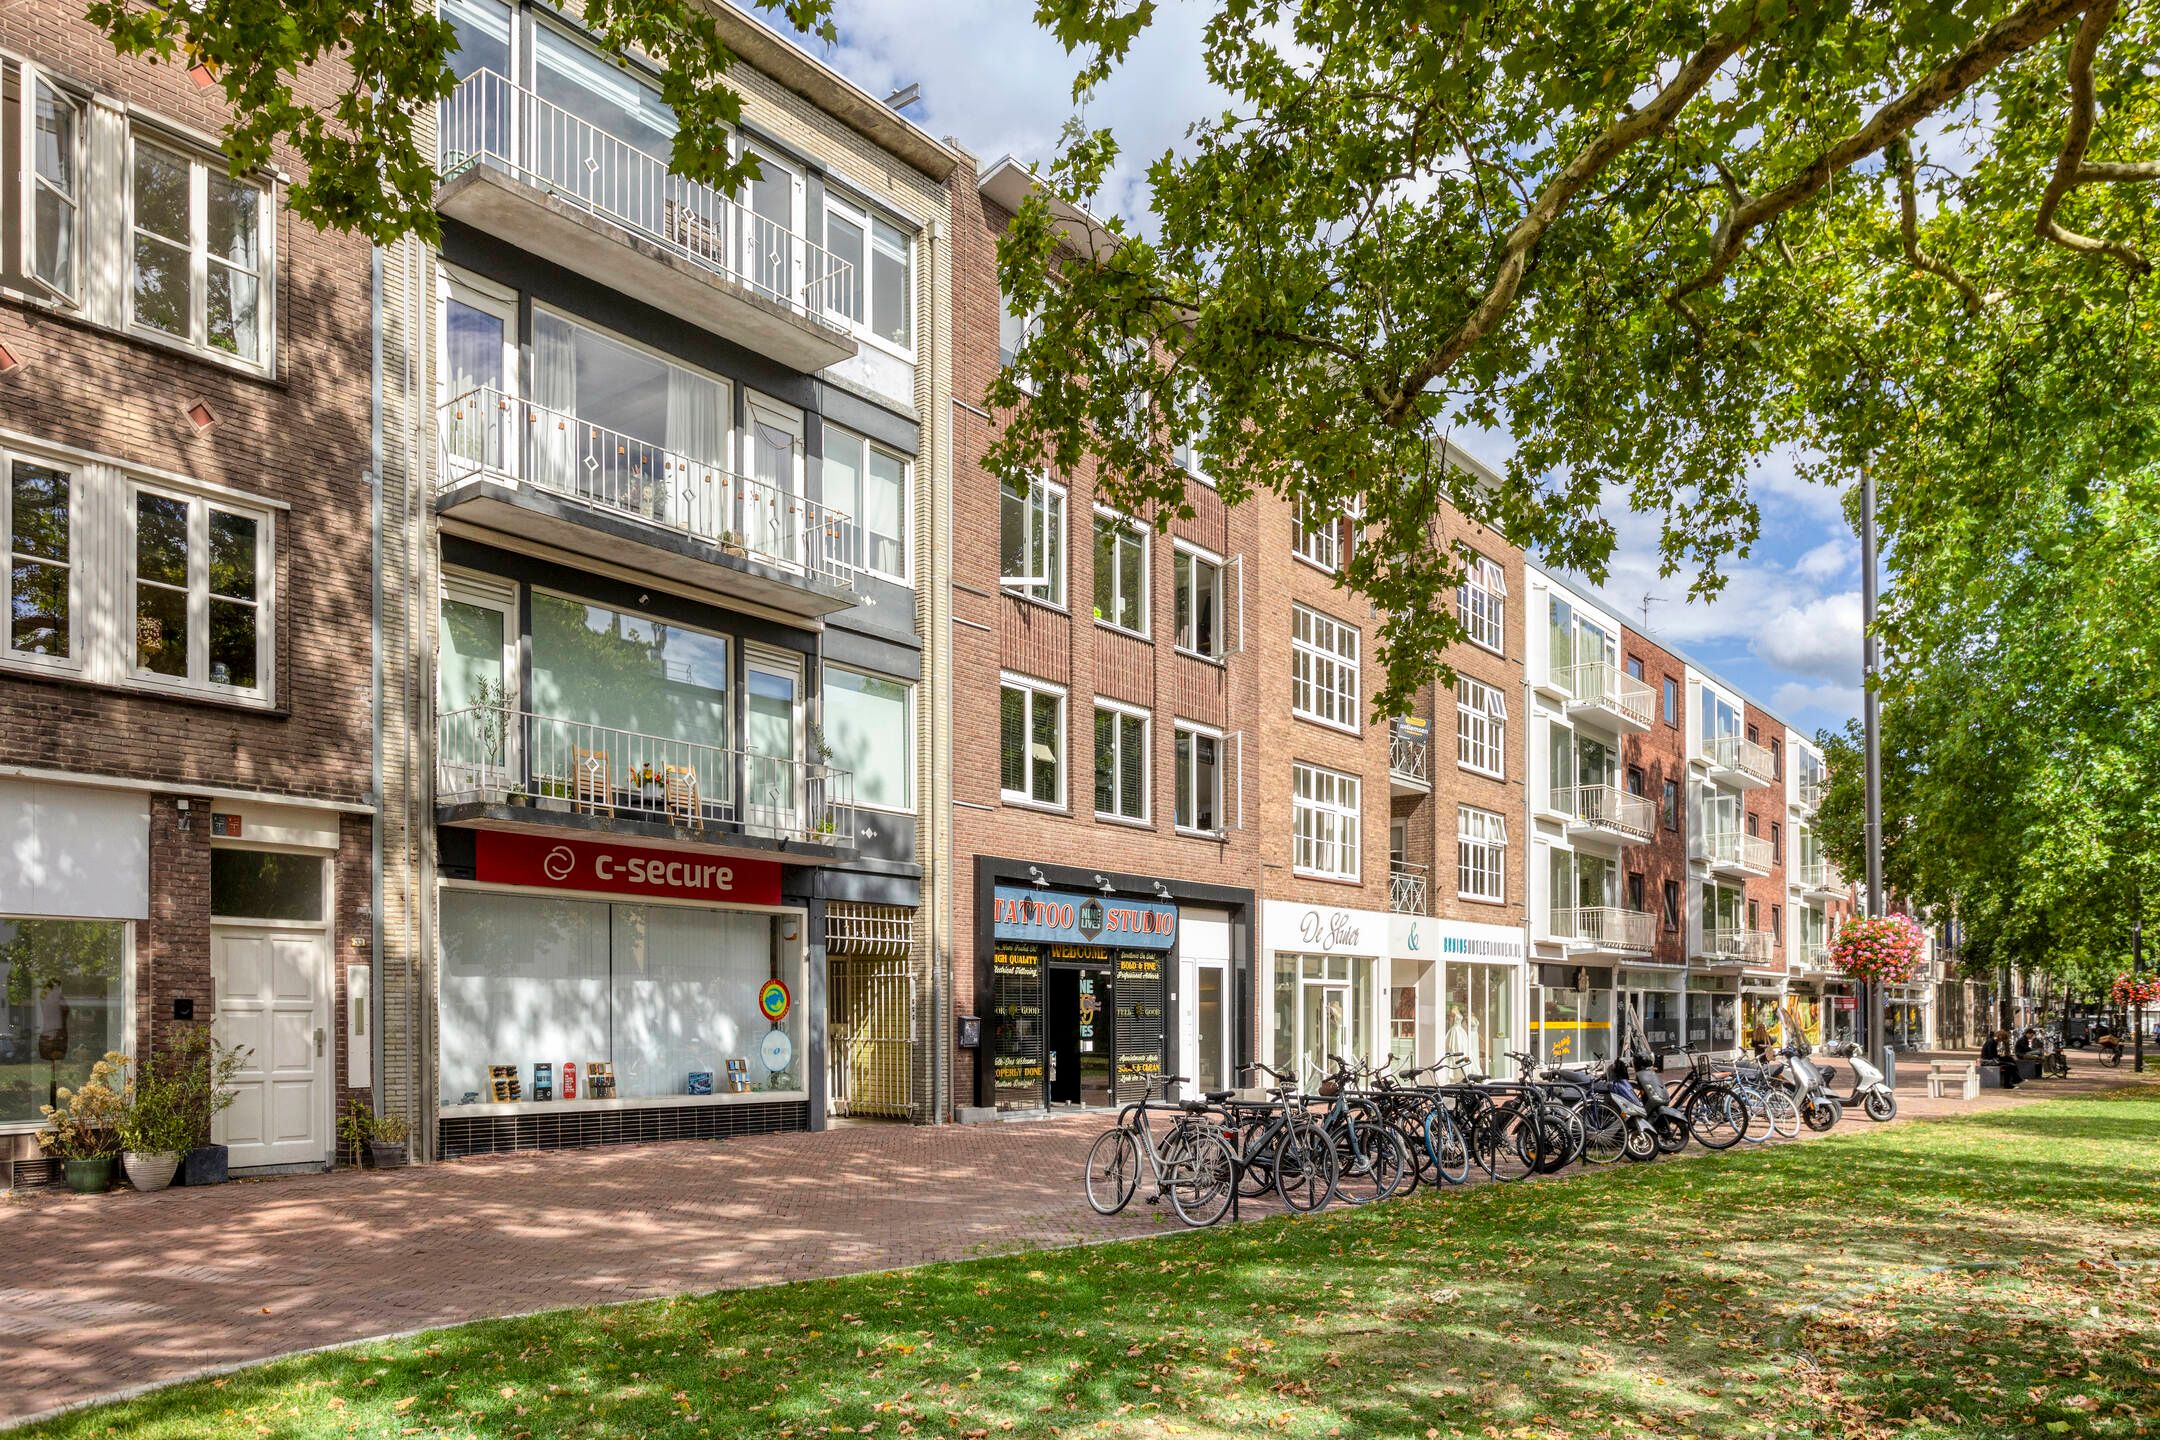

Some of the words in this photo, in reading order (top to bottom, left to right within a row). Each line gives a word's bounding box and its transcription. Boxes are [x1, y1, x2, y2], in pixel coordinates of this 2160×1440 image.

[595, 854, 734, 891] c-secure
[995, 897, 1074, 929] TATTOO
[1106, 907, 1174, 936] STUDIO
[1081, 907, 1101, 919] NINE
[1081, 918, 1101, 929] LIVES
[1300, 910, 1323, 943] De
[1407, 921, 1420, 951] &
[994, 954, 1008, 964] IGH
[1009, 954, 1038, 965] QUALITY
[1080, 979, 1094, 994] NE
[995, 1068, 1022, 1078] OPERY
[1024, 1067, 1043, 1076] DONE
